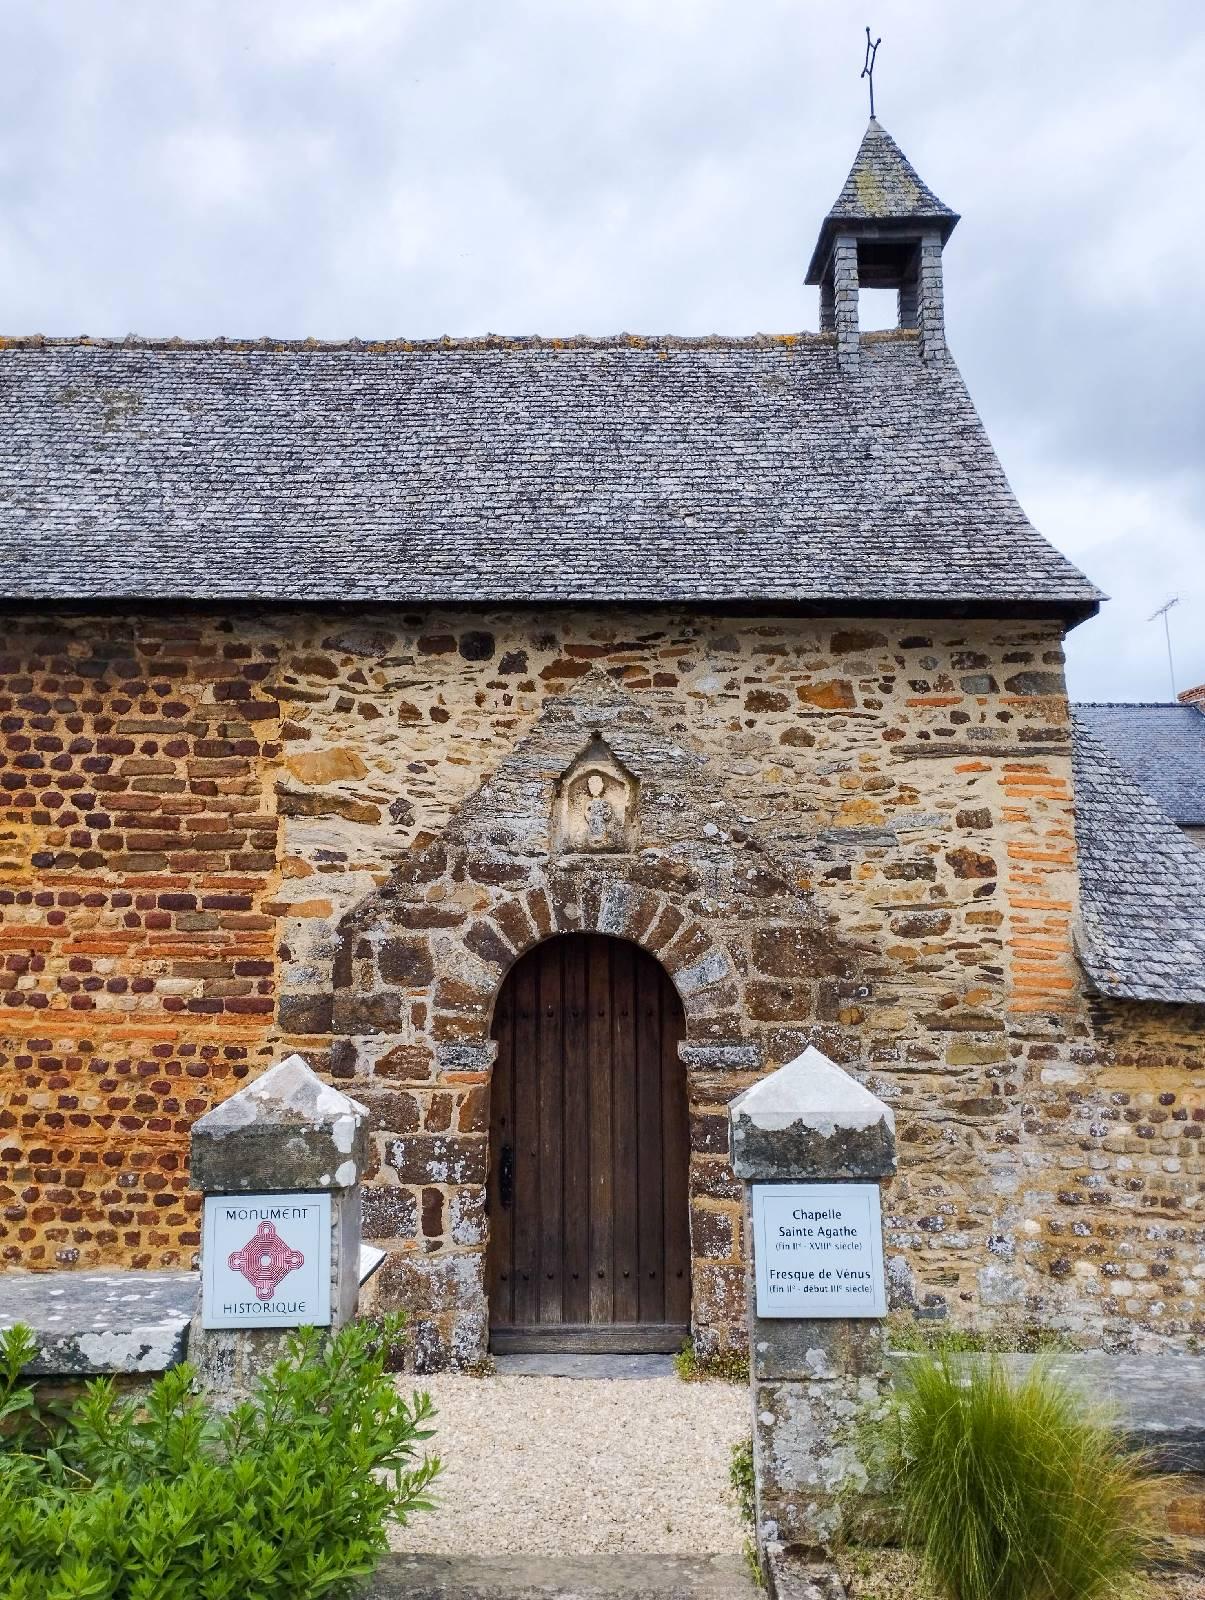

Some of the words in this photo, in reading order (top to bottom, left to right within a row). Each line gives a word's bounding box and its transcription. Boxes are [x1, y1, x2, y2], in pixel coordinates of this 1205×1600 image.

[226, 1208, 308, 1221] MONUMENT
[792, 1209, 842, 1221] Chapelle
[779, 1226, 814, 1237] Sainte
[817, 1226, 857, 1238] Agathe
[775, 1242, 790, 1251] (fin
[770, 1269, 815, 1281] Fresque
[818, 1269, 832, 1279] de
[836, 1268, 871, 1279] Vénus
[769, 1285, 784, 1294] (fin
[803, 1284, 828, 1293] début
[223, 1302, 306, 1314] HISTORIQUE
